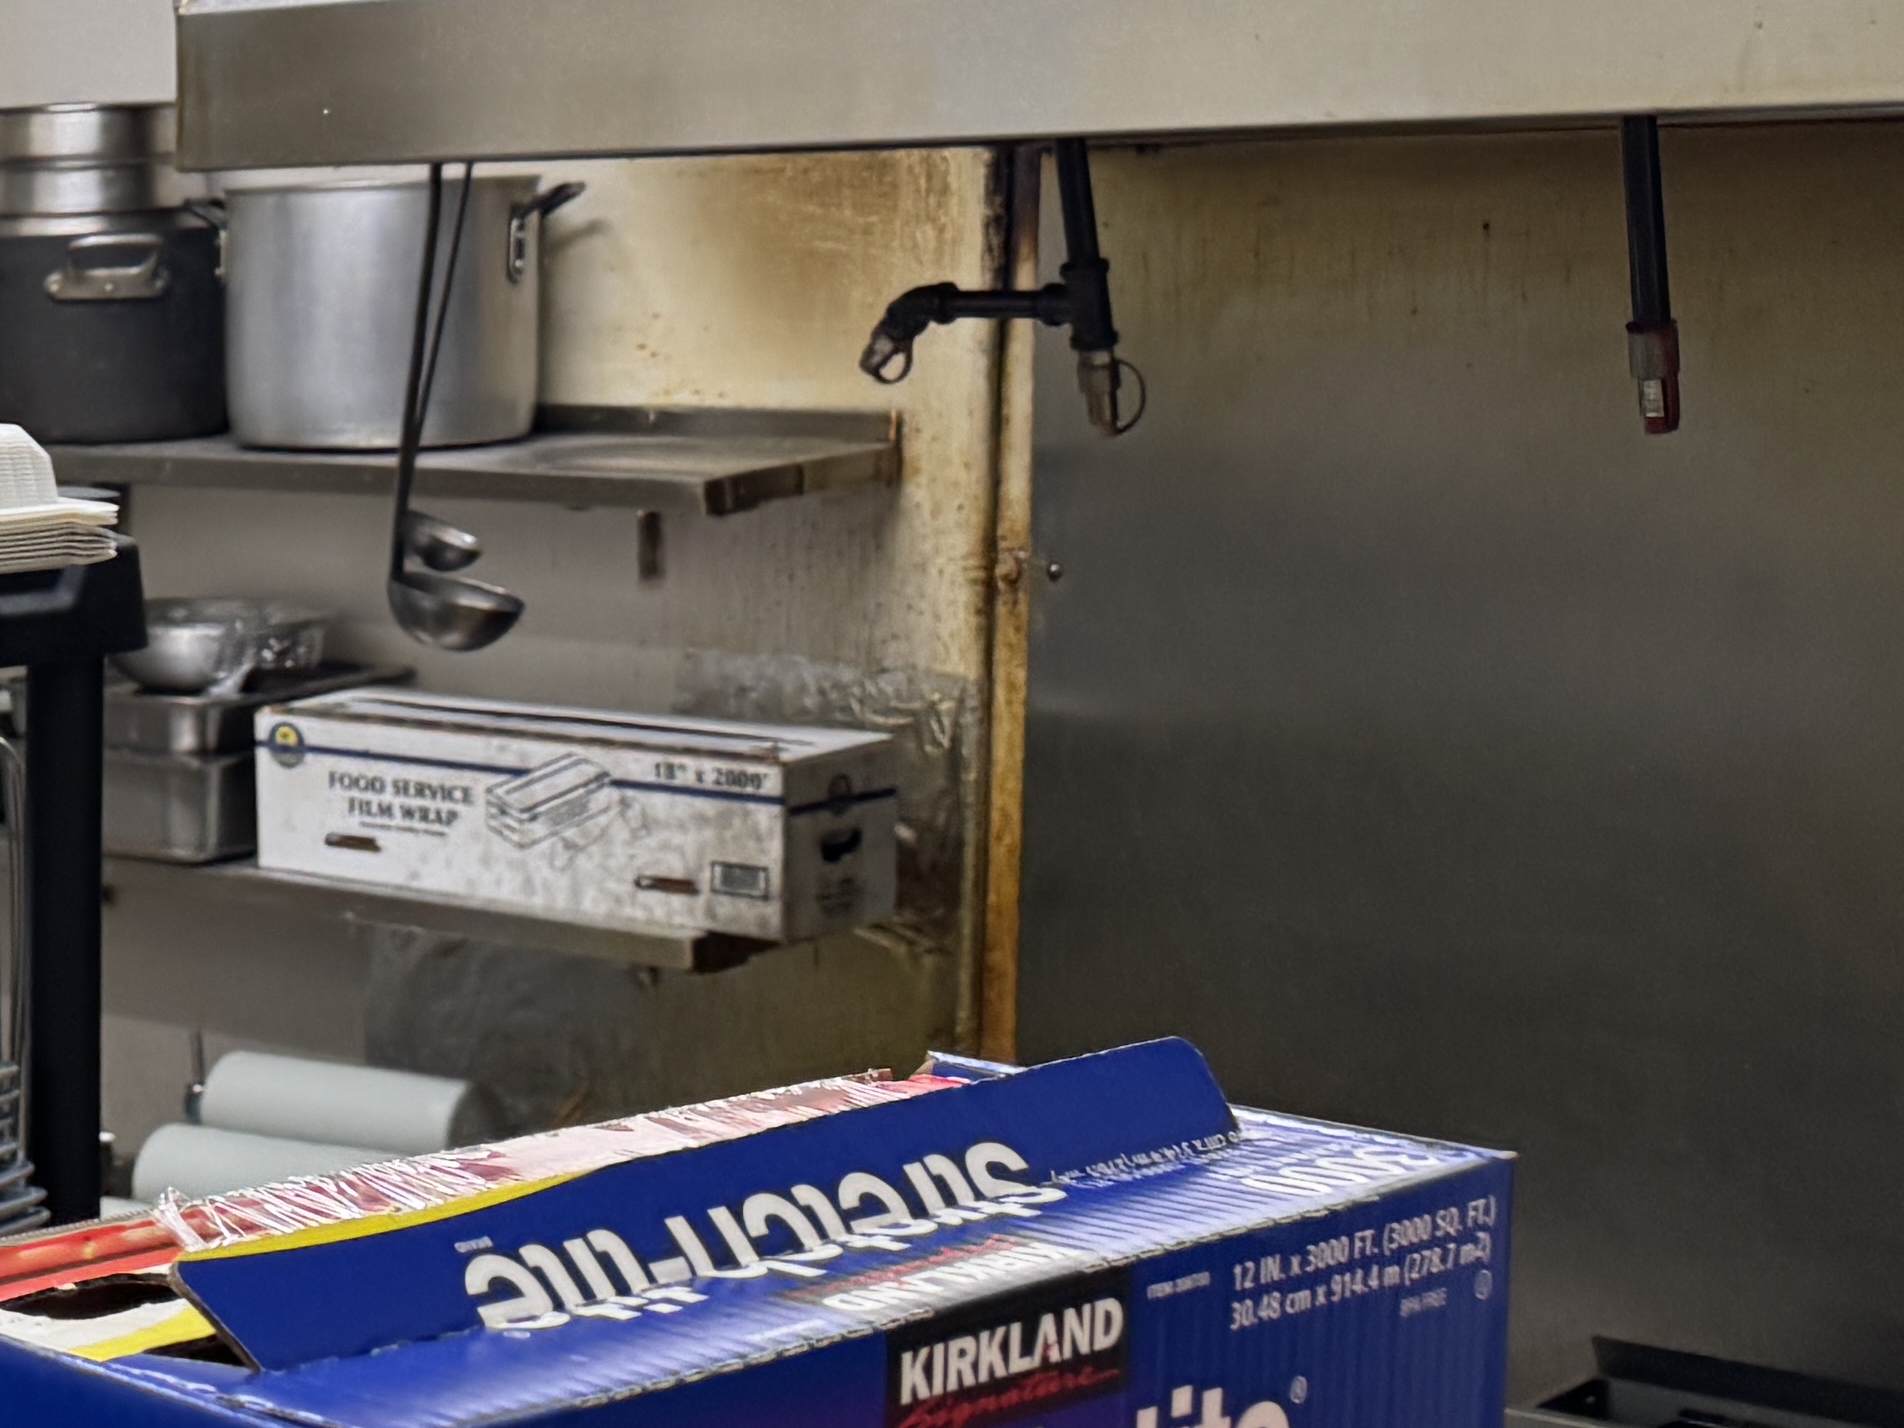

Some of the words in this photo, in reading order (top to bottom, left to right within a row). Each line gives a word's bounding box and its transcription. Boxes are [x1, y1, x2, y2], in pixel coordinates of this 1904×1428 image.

[328, 770, 386, 795] FOOD
[393, 778, 474, 806] SERVICE
[348, 796, 393, 820] FILM
[399, 804, 459, 827] WRAP
[821, 1240, 1092, 1312] KIRKLAND
[1233, 1261, 1255, 1291] 12
[1259, 1255, 1285, 1284] IN.
[1289, 1253, 1301, 1276] x
[1305, 1236, 1349, 1272] 3000
[1354, 1229, 1379, 1260] FT.
[1383, 1214, 1433, 1256] (3000
[1435, 1206, 1463, 1238] SQ.
[1467, 1195, 1496, 1228] FT.)
[1230, 1291, 1282, 1331] 30.48
[1285, 1288, 1312, 1314] cm
[1315, 1284, 1326, 1306] x
[1330, 1264, 1380, 1302] 914.4
[1383, 1265, 1400, 1286] m
[1404, 1244, 1456, 1285] (278.7
[900, 1297, 1124, 1405] KIRKLAND
